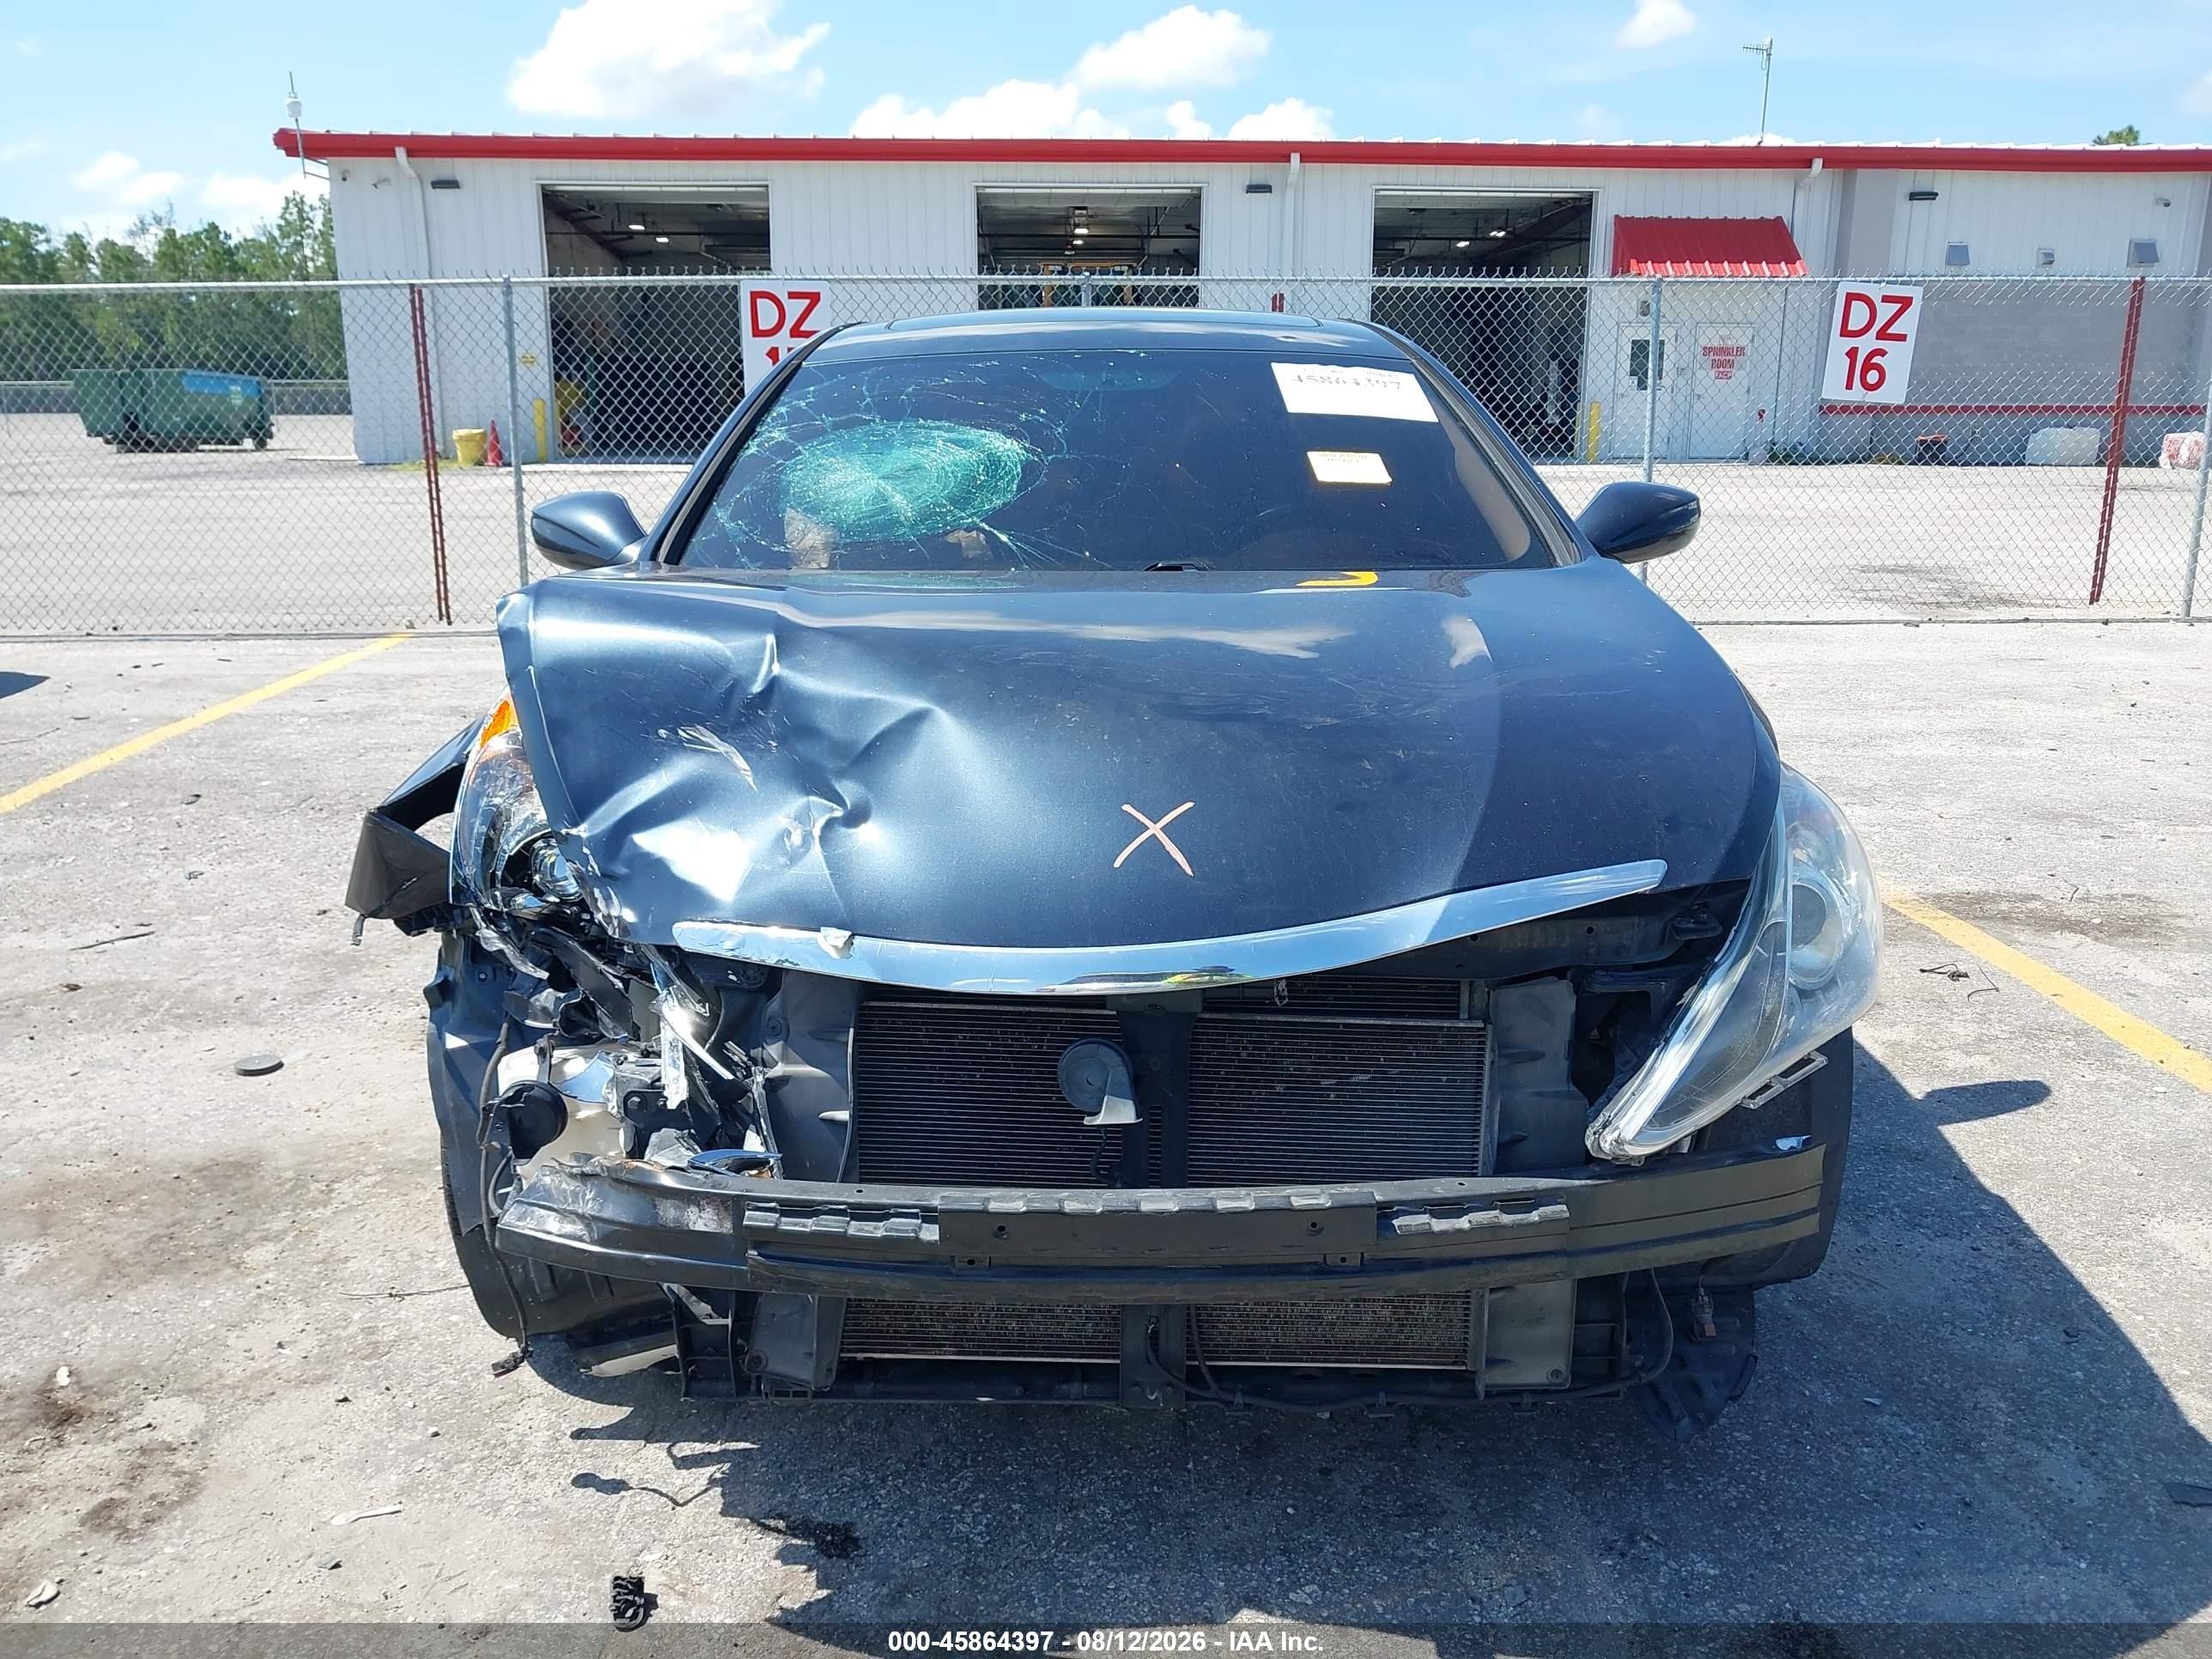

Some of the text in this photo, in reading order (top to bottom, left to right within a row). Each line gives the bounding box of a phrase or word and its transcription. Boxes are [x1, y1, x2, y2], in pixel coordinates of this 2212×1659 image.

[749, 290, 822, 338] DZ
[1838, 291, 1914, 343] DZ
[1702, 346, 1746, 357] SPRINKLER
[1711, 358, 1735, 369] ROOM
[1844, 345, 1889, 392] 16
